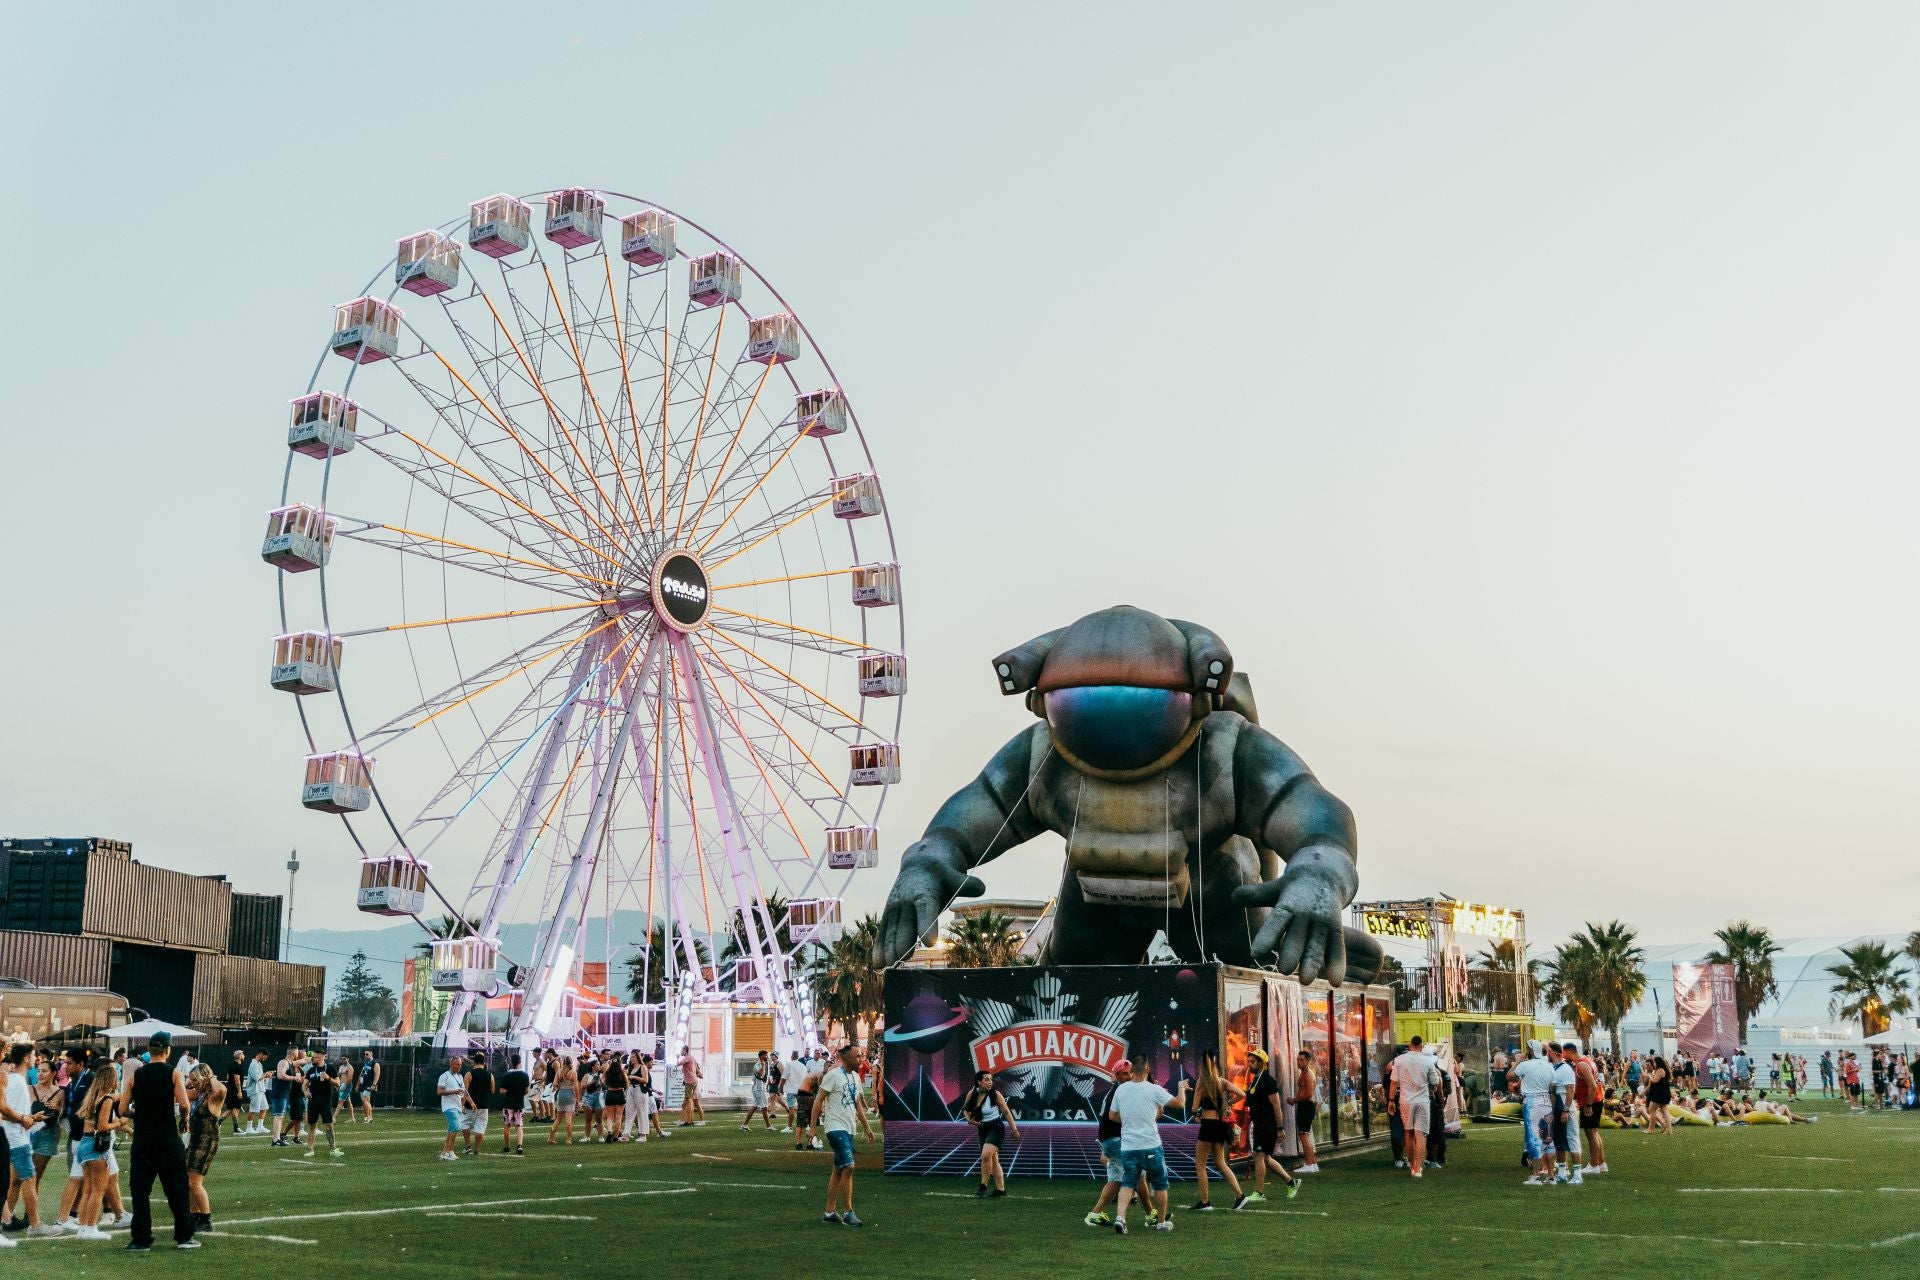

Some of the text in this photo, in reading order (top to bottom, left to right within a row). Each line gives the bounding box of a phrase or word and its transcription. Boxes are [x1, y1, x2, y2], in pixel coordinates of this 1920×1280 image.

[1140, 893, 1177, 902] ANSWER
[985, 1030, 1114, 1069] POLIAKOV
[1012, 1109, 1088, 1121] VODKA
